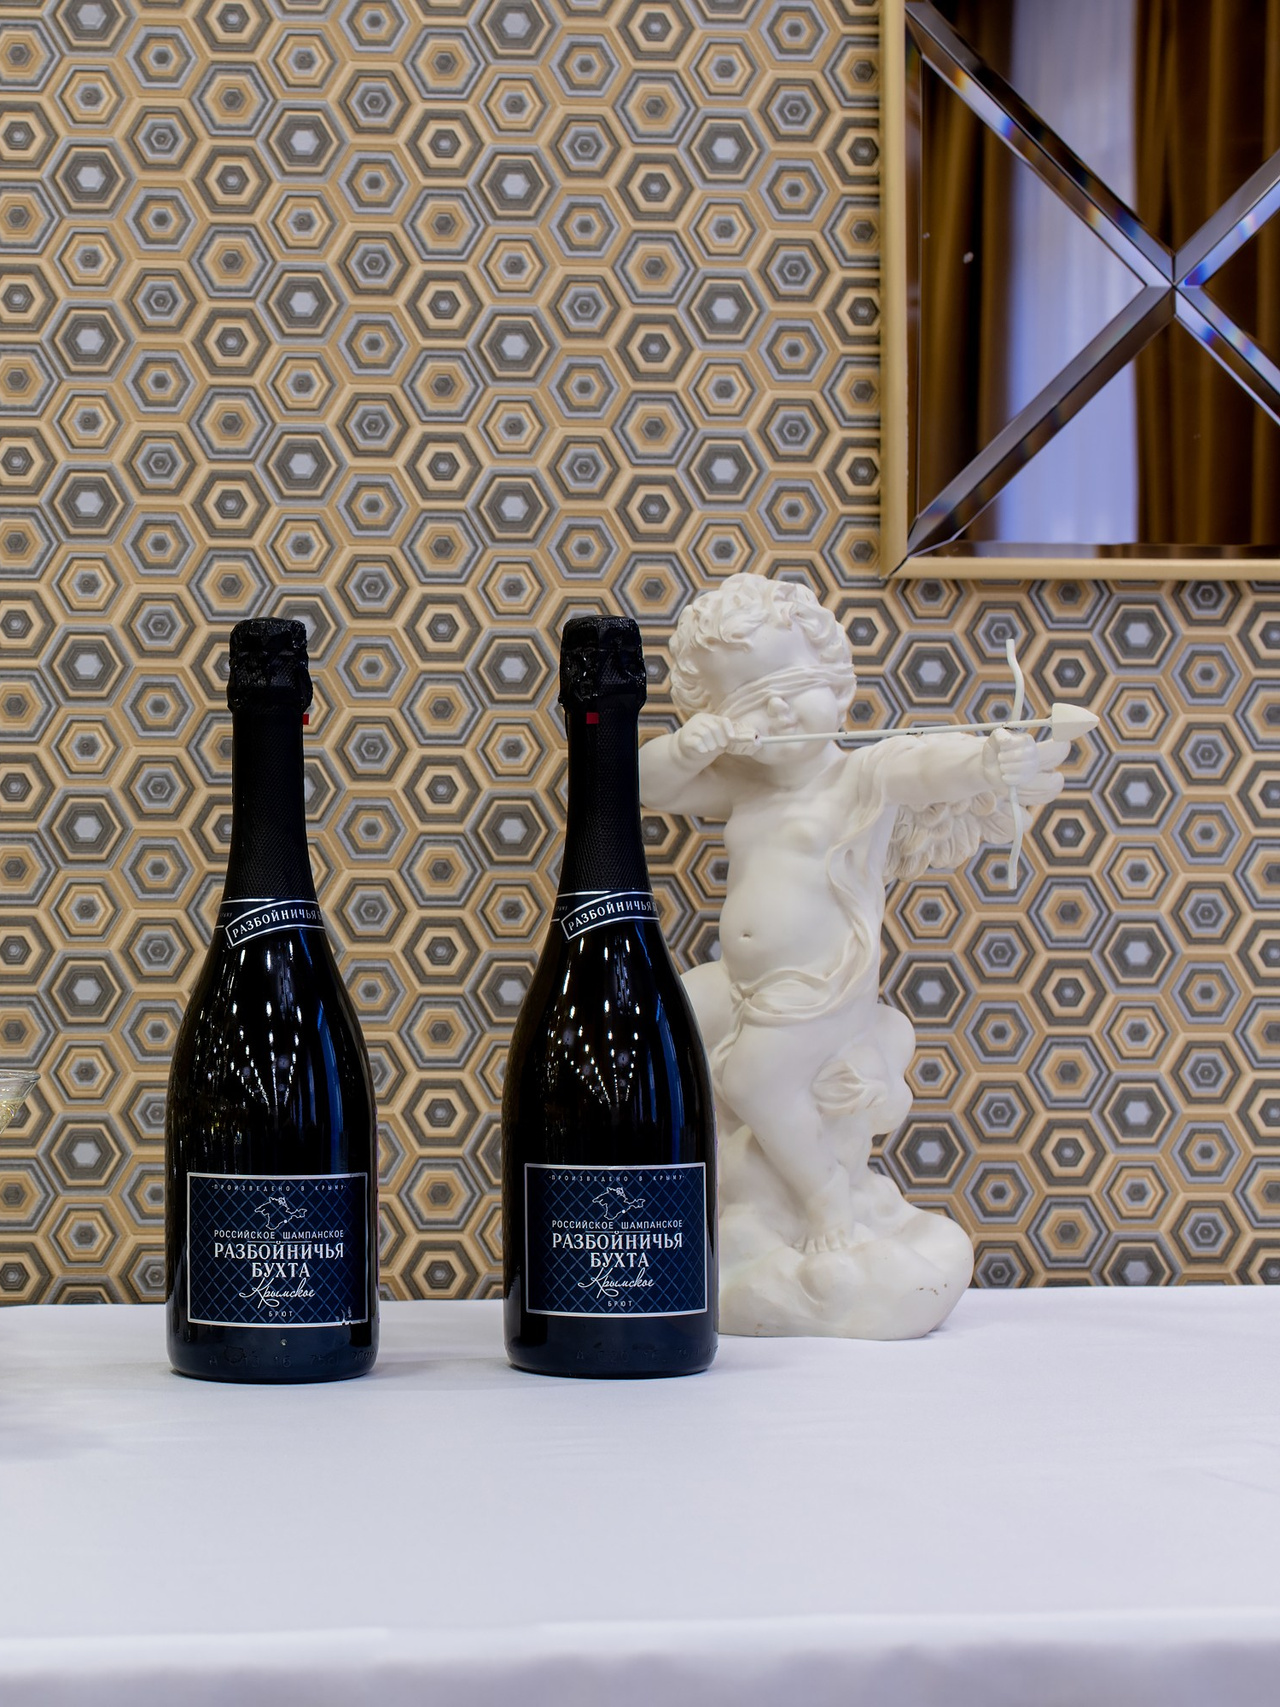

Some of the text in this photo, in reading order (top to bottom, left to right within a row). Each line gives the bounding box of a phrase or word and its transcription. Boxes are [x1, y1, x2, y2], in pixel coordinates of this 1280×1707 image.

[232, 909, 317, 938] РАЗБОЙНИЧЬЯ
[568, 900, 652, 931] РАЗБОЙНИЧЬЯ
[552, 1219, 683, 1229] РОССИЙСКОЕ ШАМПАНСКОЕ
[214, 1229, 344, 1239] РОССИЙСКОЕ ШАМПАНСКОЕ
[552, 1231, 683, 1250] РАЗБОЙНИЧЬЯ
[214, 1241, 344, 1260] РАЗБОЙНИЧЬЯ
[590, 1252, 650, 1268] БУХТА
[252, 1262, 311, 1278] БУХТА
[577, 1267, 655, 1299] Крымское
[238, 1277, 317, 1309] Крымское
[268, 1310, 294, 1318] БРЮТ
